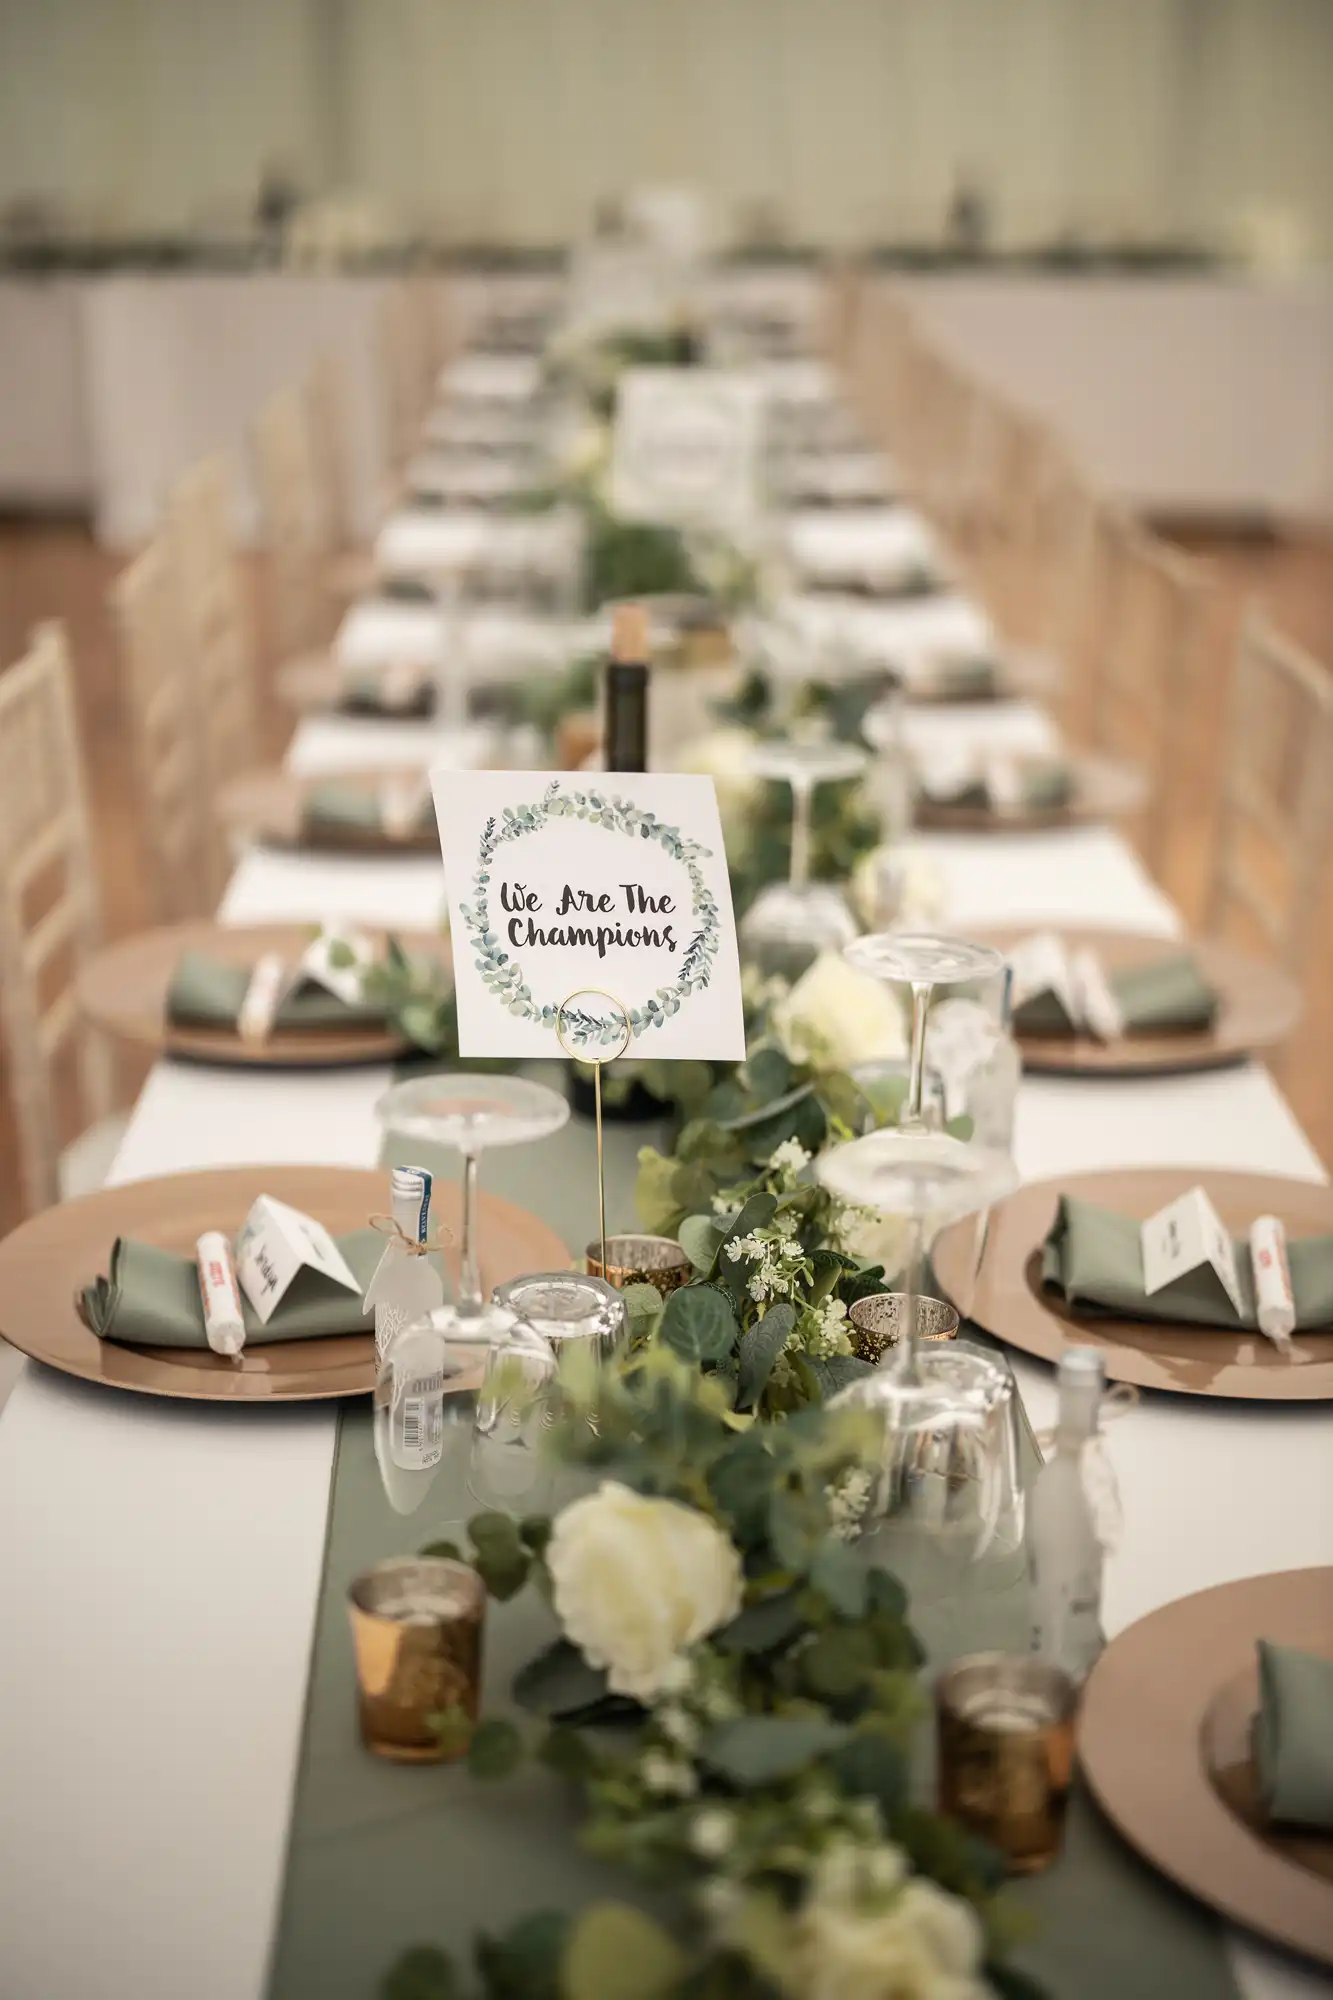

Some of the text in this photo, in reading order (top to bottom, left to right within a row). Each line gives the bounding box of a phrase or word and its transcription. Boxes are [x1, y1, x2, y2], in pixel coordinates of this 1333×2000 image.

[501, 882, 676, 916] We Are The
[507, 917, 678, 959] Champions
